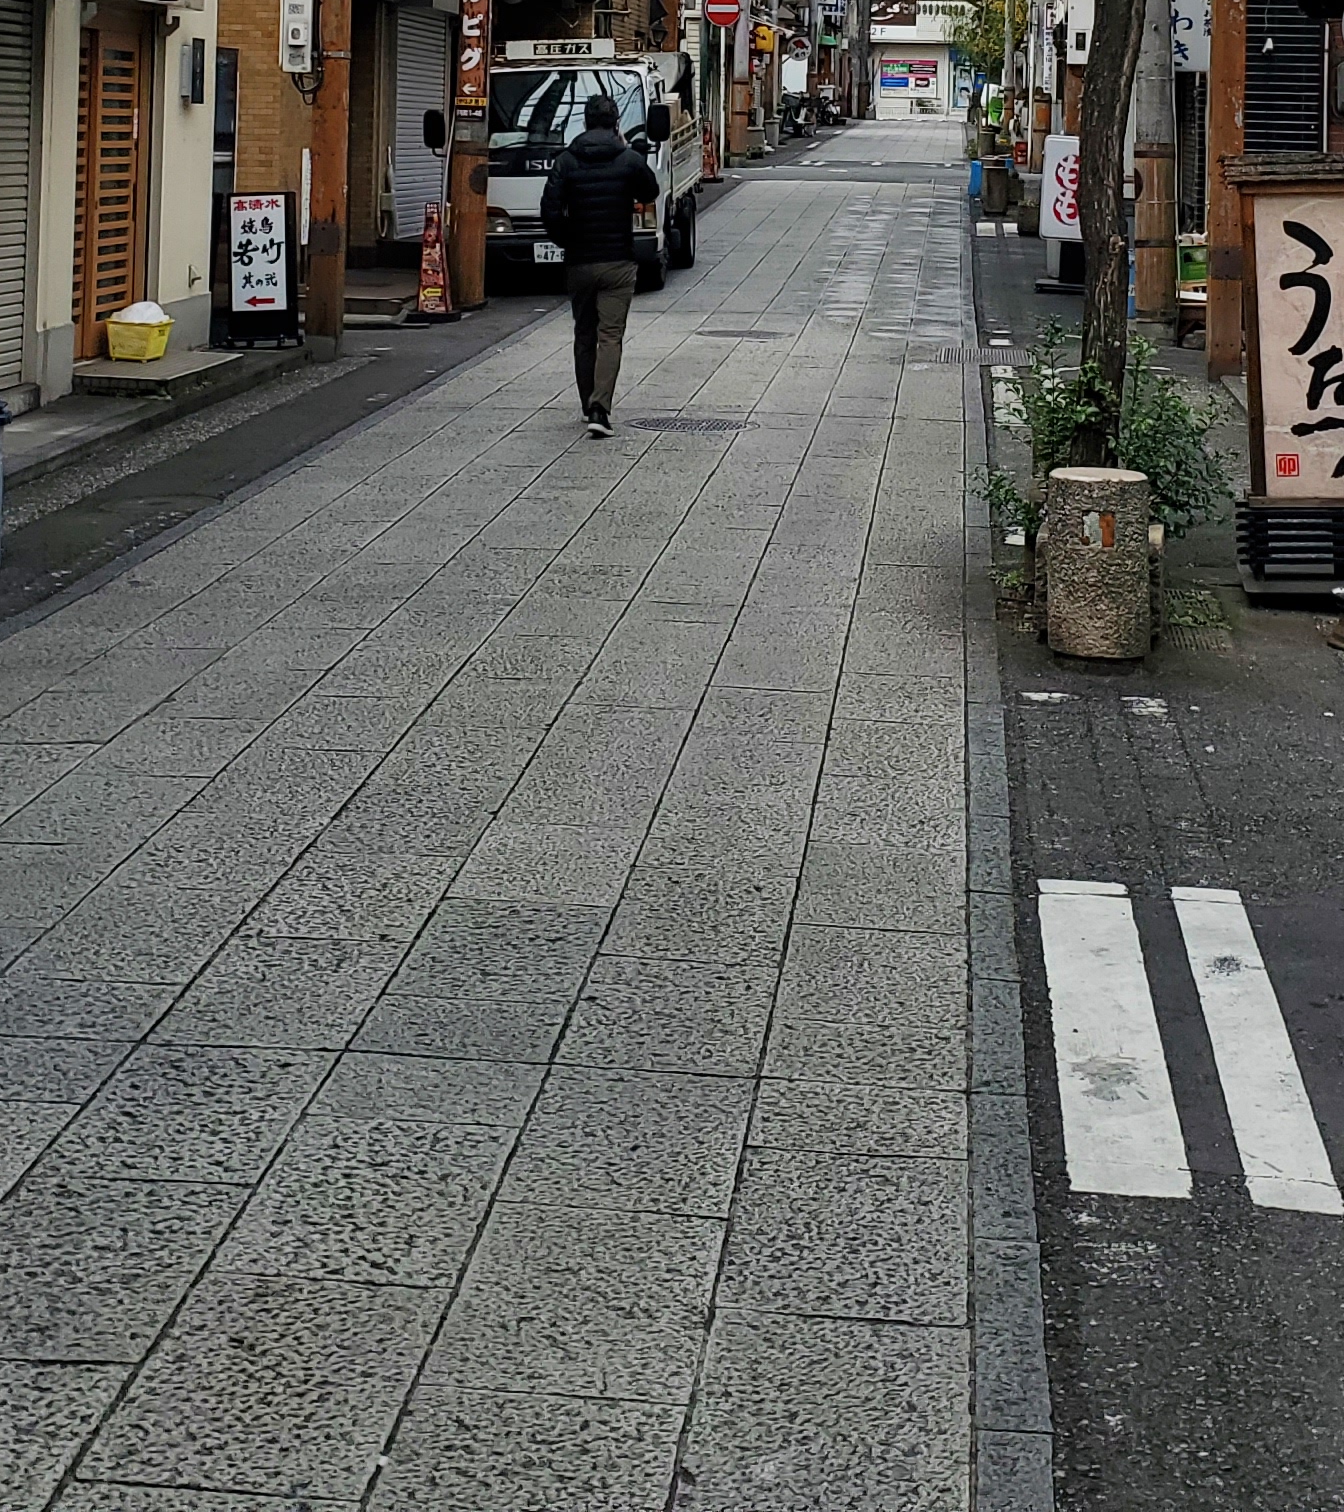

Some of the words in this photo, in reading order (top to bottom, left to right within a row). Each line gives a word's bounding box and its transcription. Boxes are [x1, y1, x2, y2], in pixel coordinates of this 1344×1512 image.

[535, 43, 590, 55] 高圧ガス
[232, 238, 285, 267] 若竹
